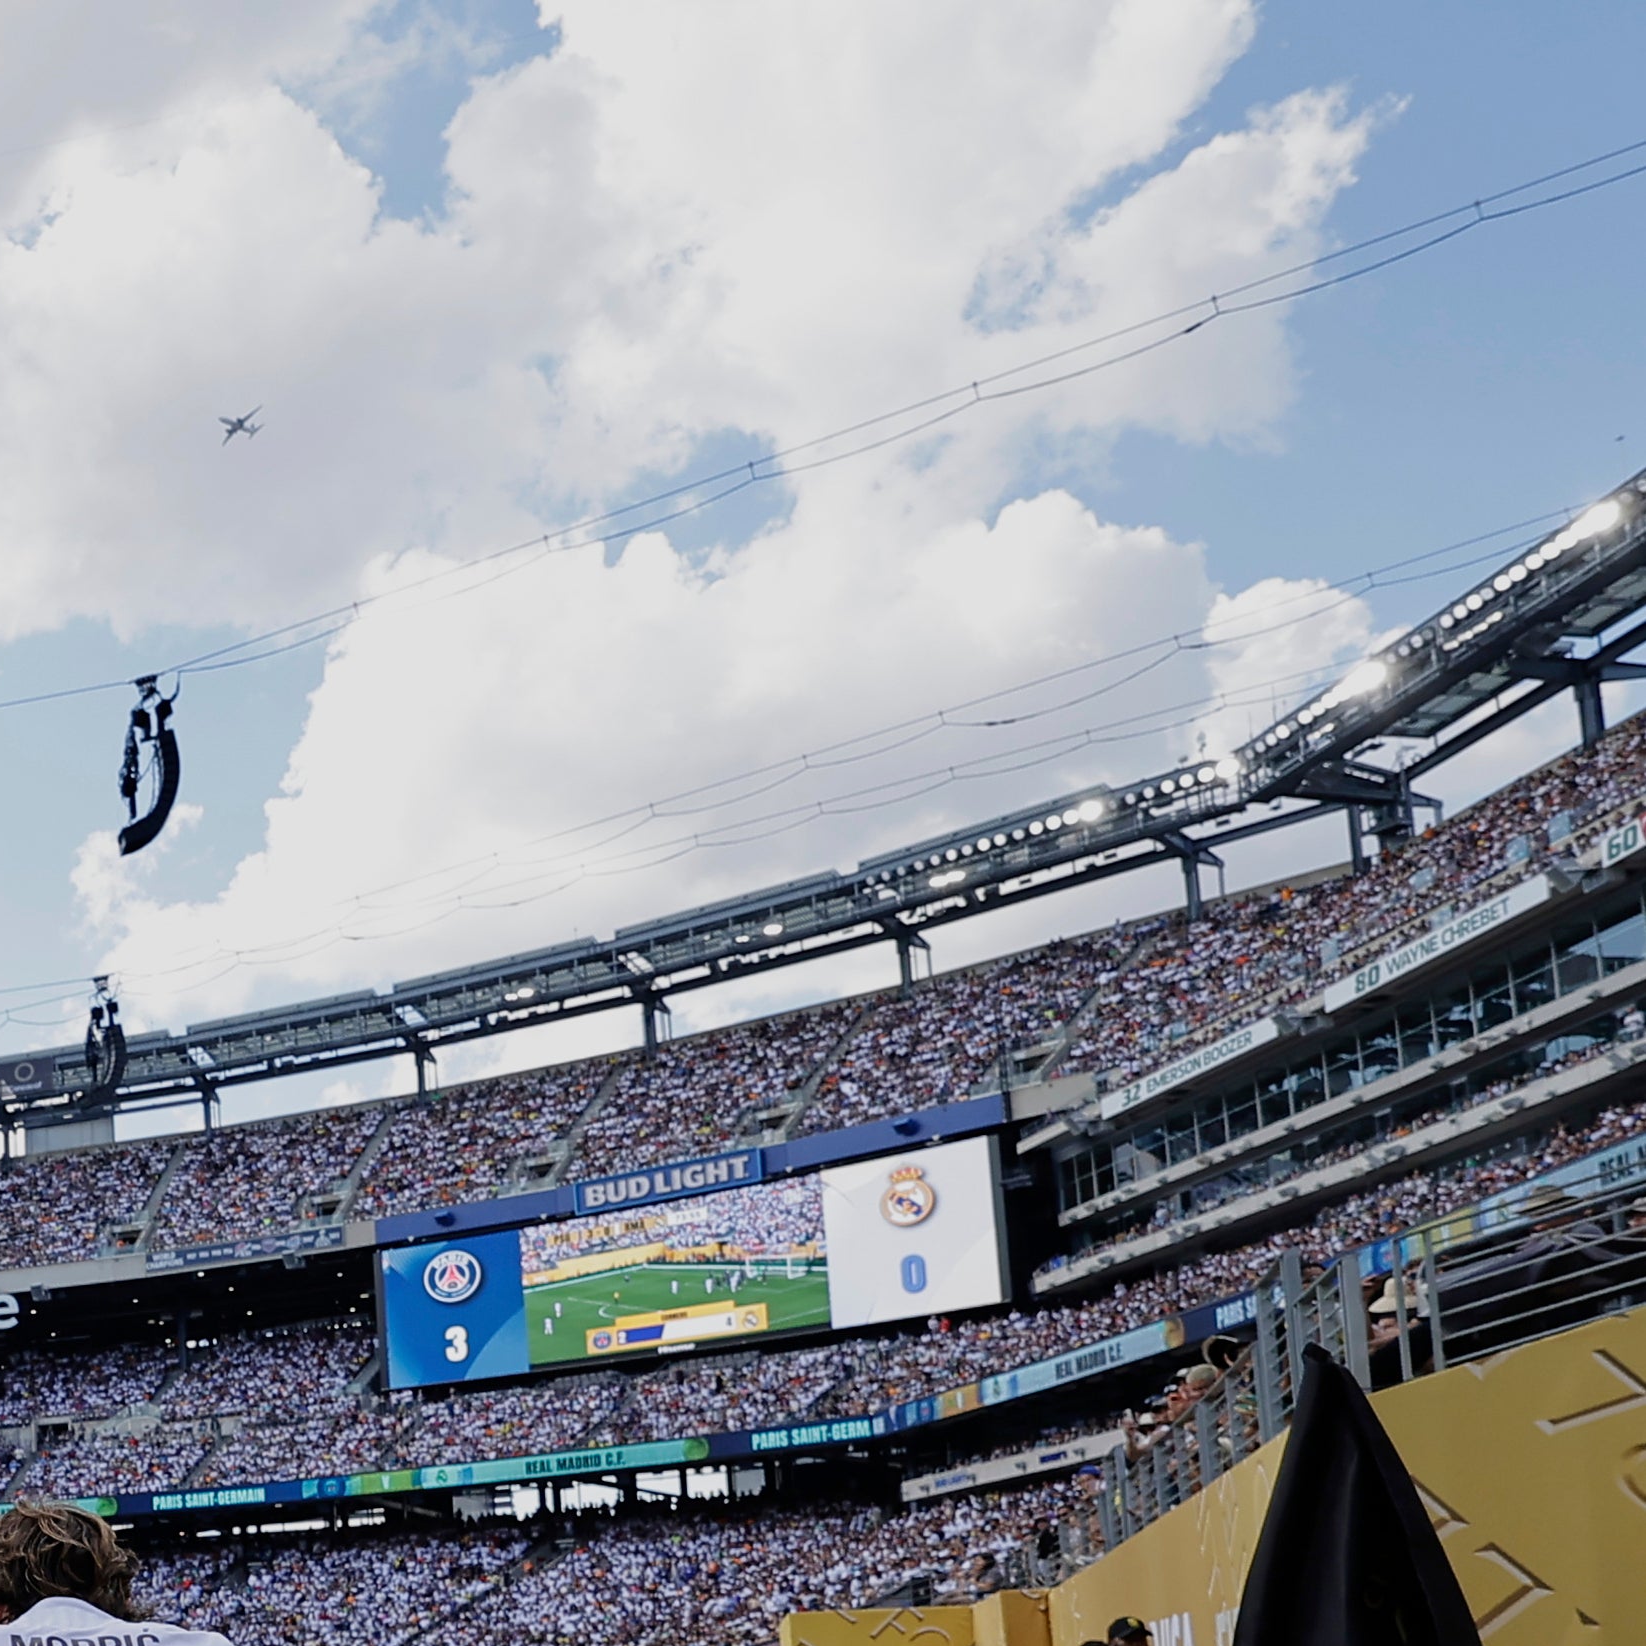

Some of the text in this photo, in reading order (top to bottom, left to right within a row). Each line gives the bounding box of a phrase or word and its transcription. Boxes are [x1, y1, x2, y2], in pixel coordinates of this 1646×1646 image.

[1608, 827, 1639, 861] 60
[1354, 897, 1510, 994] 80 WAYNE CHREBET
[1121, 1031, 1253, 1107] 32 EMERSON BOOZER
[583, 1154, 749, 1209] BUD LIGHT
[900, 1254, 927, 1295] 0
[444, 1326, 469, 1363] 3
[1055, 1362, 1075, 1382] REAL
[1076, 1351, 1106, 1375] MADRID
[751, 1430, 789, 1452] PARIS
[524, 1452, 627, 1475] REAL MADRID C.F.
[152, 1487, 266, 1511] PARIS SAINT-GERMAIN
